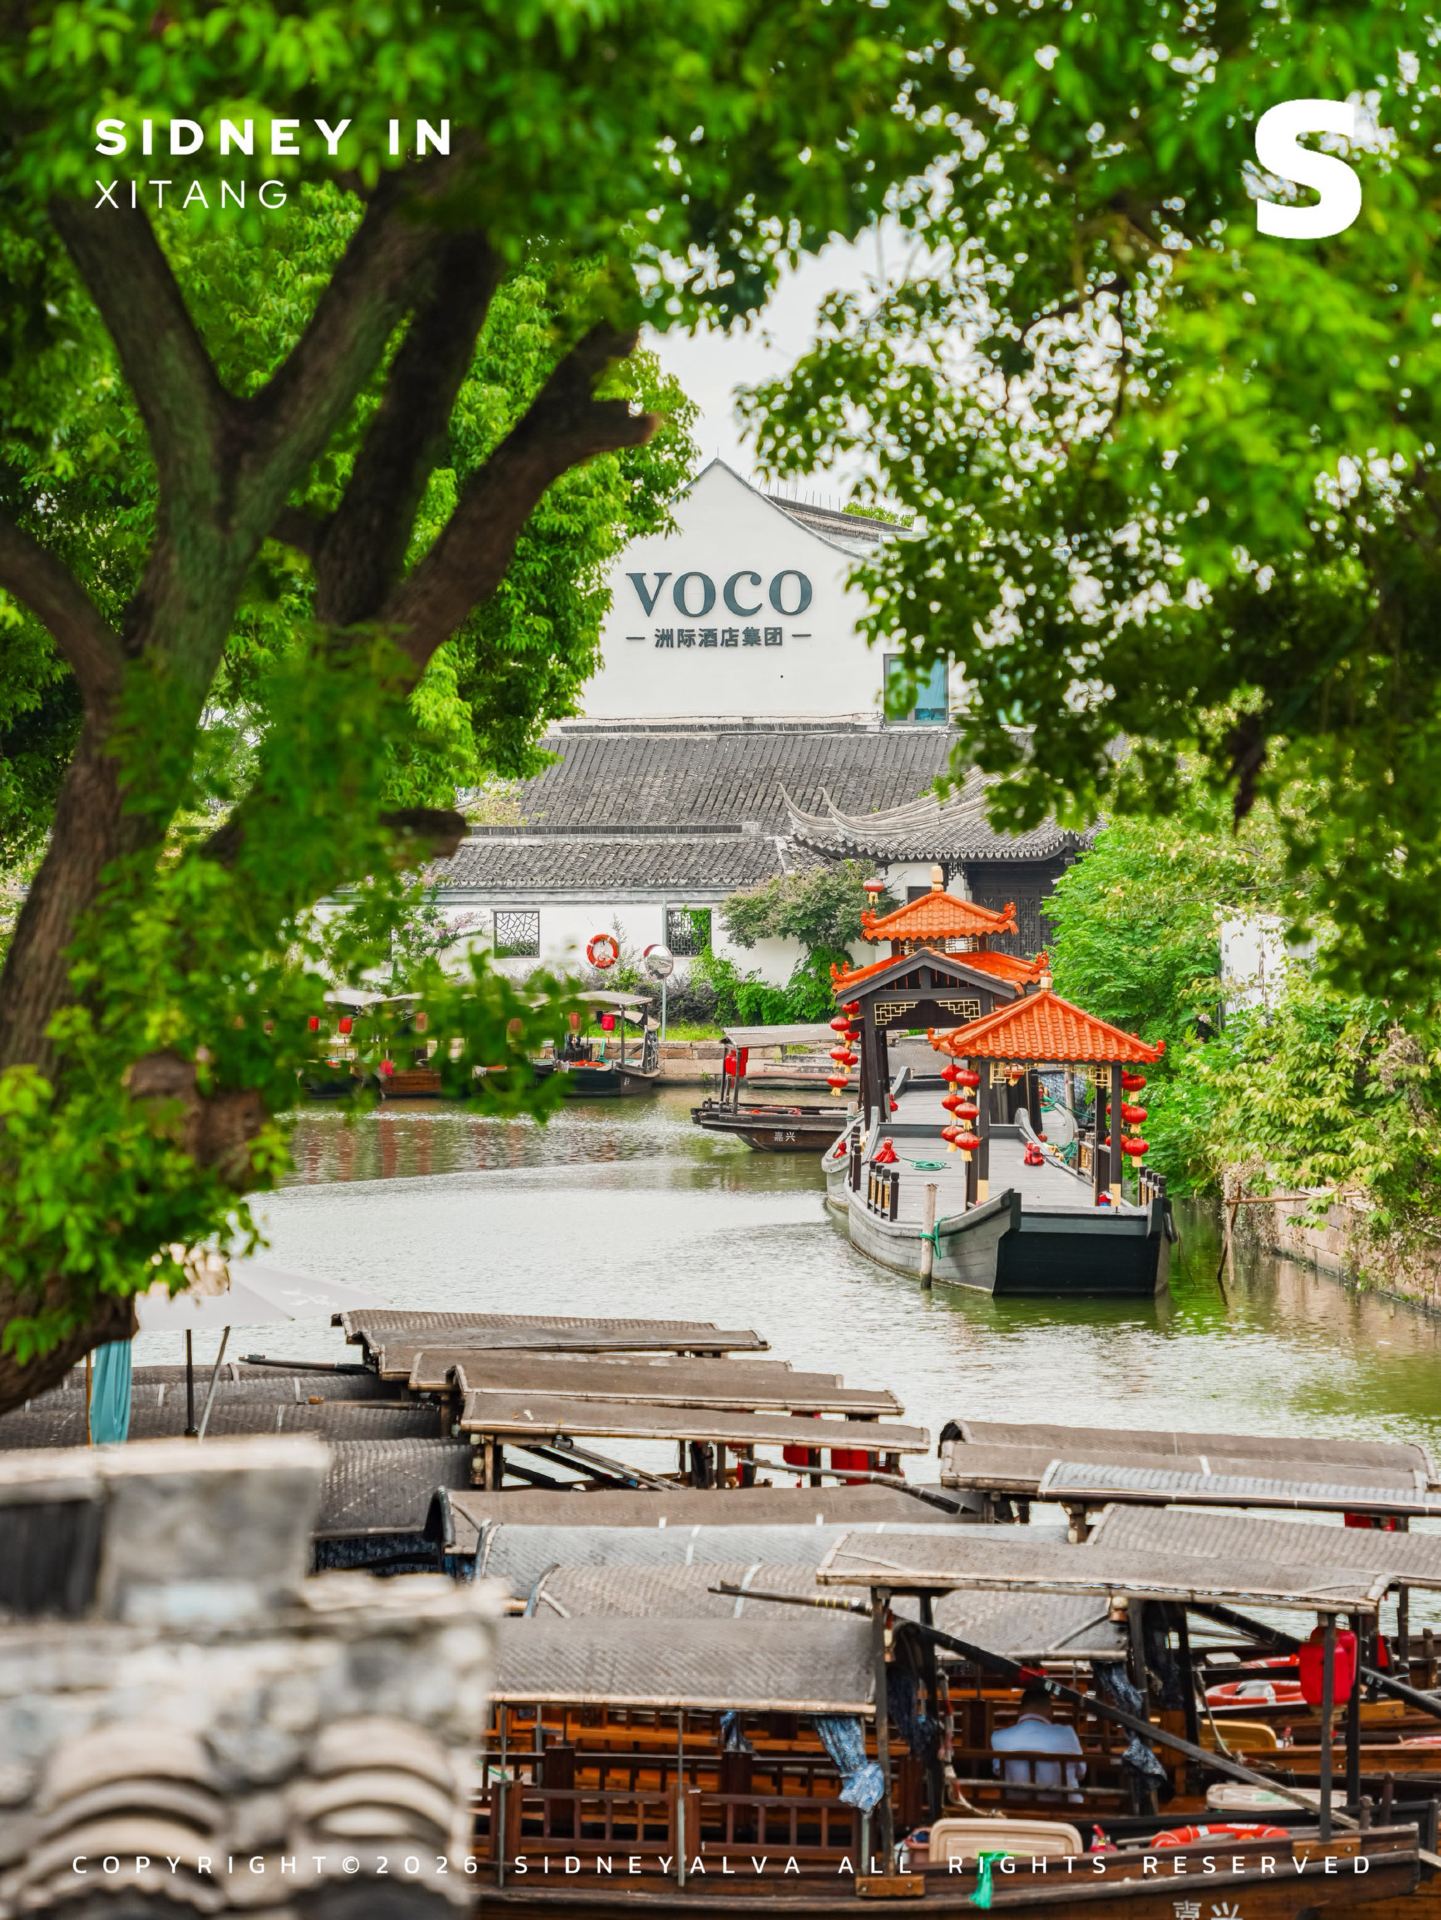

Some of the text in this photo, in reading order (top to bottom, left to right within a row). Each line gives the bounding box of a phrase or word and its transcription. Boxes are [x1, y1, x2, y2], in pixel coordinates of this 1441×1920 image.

[654, 626, 783, 648] 洲际酒店集团
[774, 1131, 796, 1142] 嘉兴
